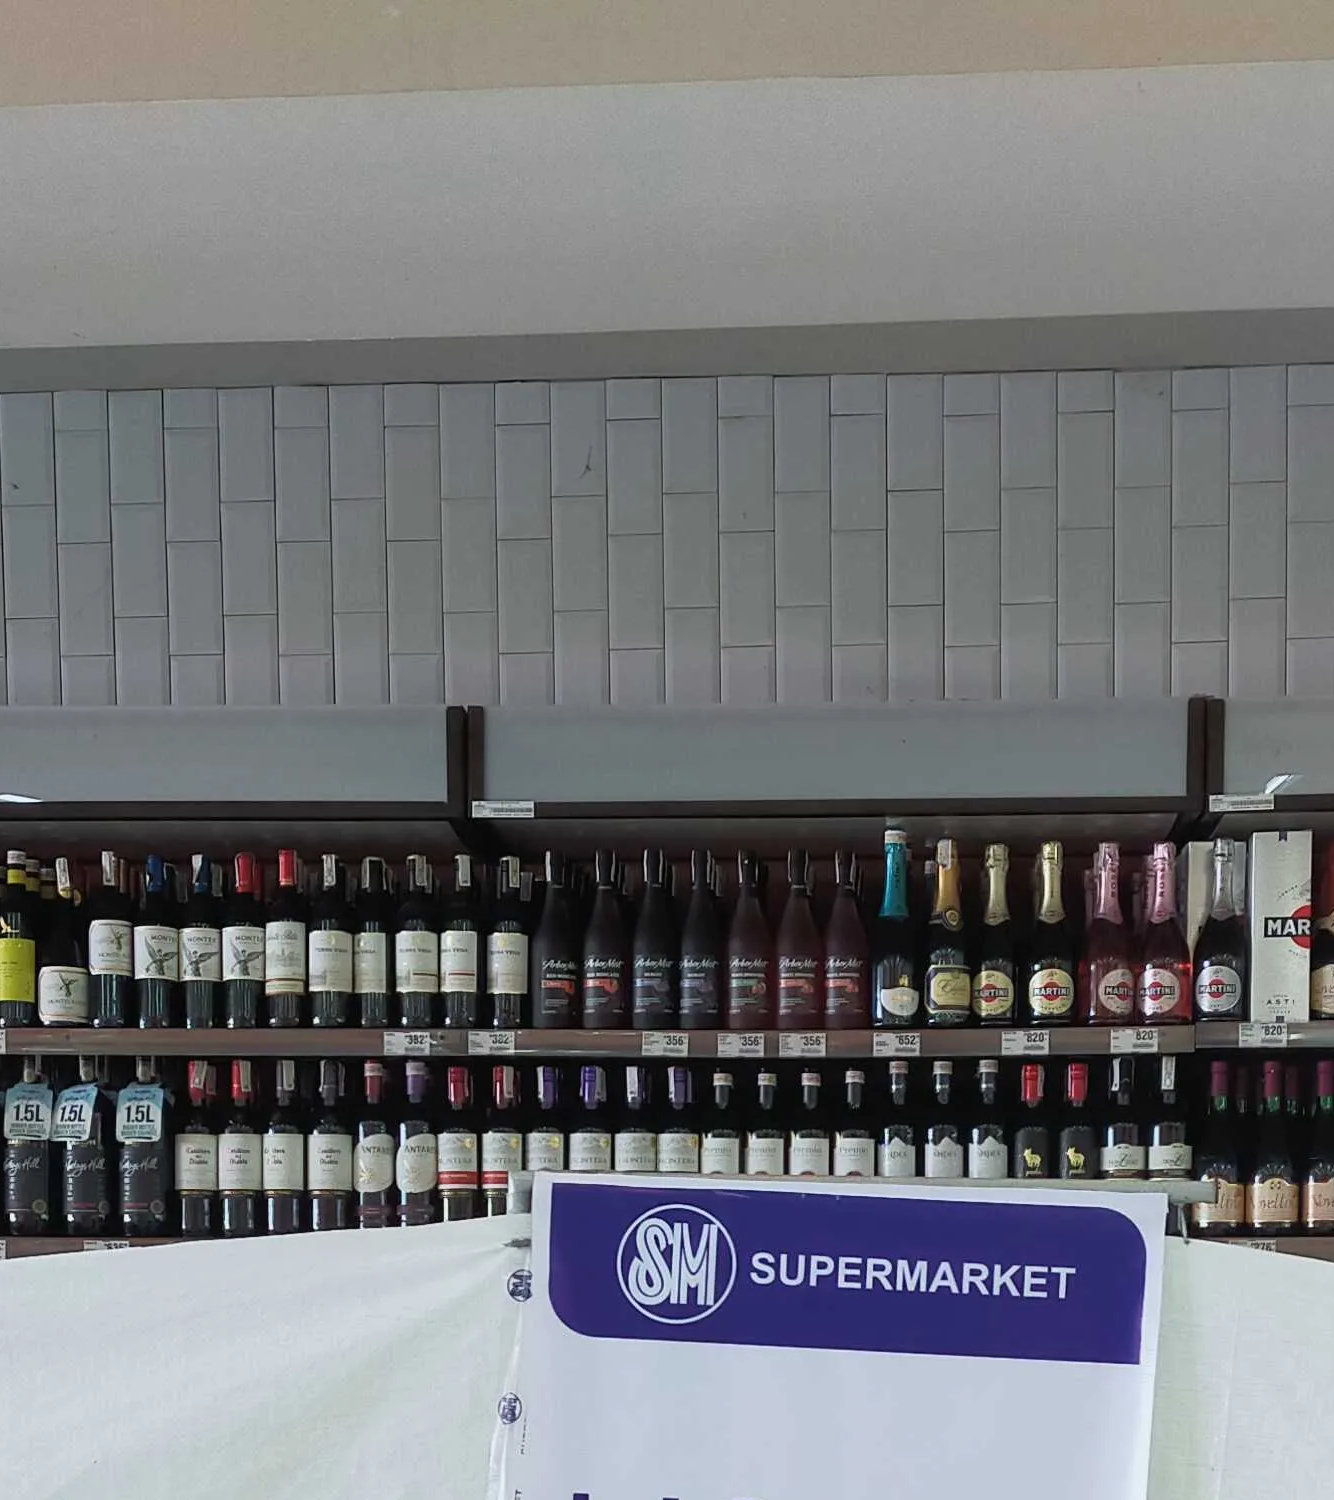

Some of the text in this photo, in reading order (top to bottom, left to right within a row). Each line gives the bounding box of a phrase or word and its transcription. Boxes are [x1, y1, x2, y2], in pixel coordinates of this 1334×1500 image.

[1033, 988, 1068, 997] MARTINI
[1199, 984, 1236, 993] MARTINI
[1266, 998, 1295, 1006] ASTI
[666, 1036, 684, 1046] 356
[741, 1036, 759, 1046] 356
[803, 1036, 821, 1046] 356
[14, 1103, 44, 1122] 1.5L
[60, 1104, 85, 1123] 1.5L
[125, 1105, 155, 1123] 1.5L
[626, 1215, 1077, 1308] SM SUPERMARKET
